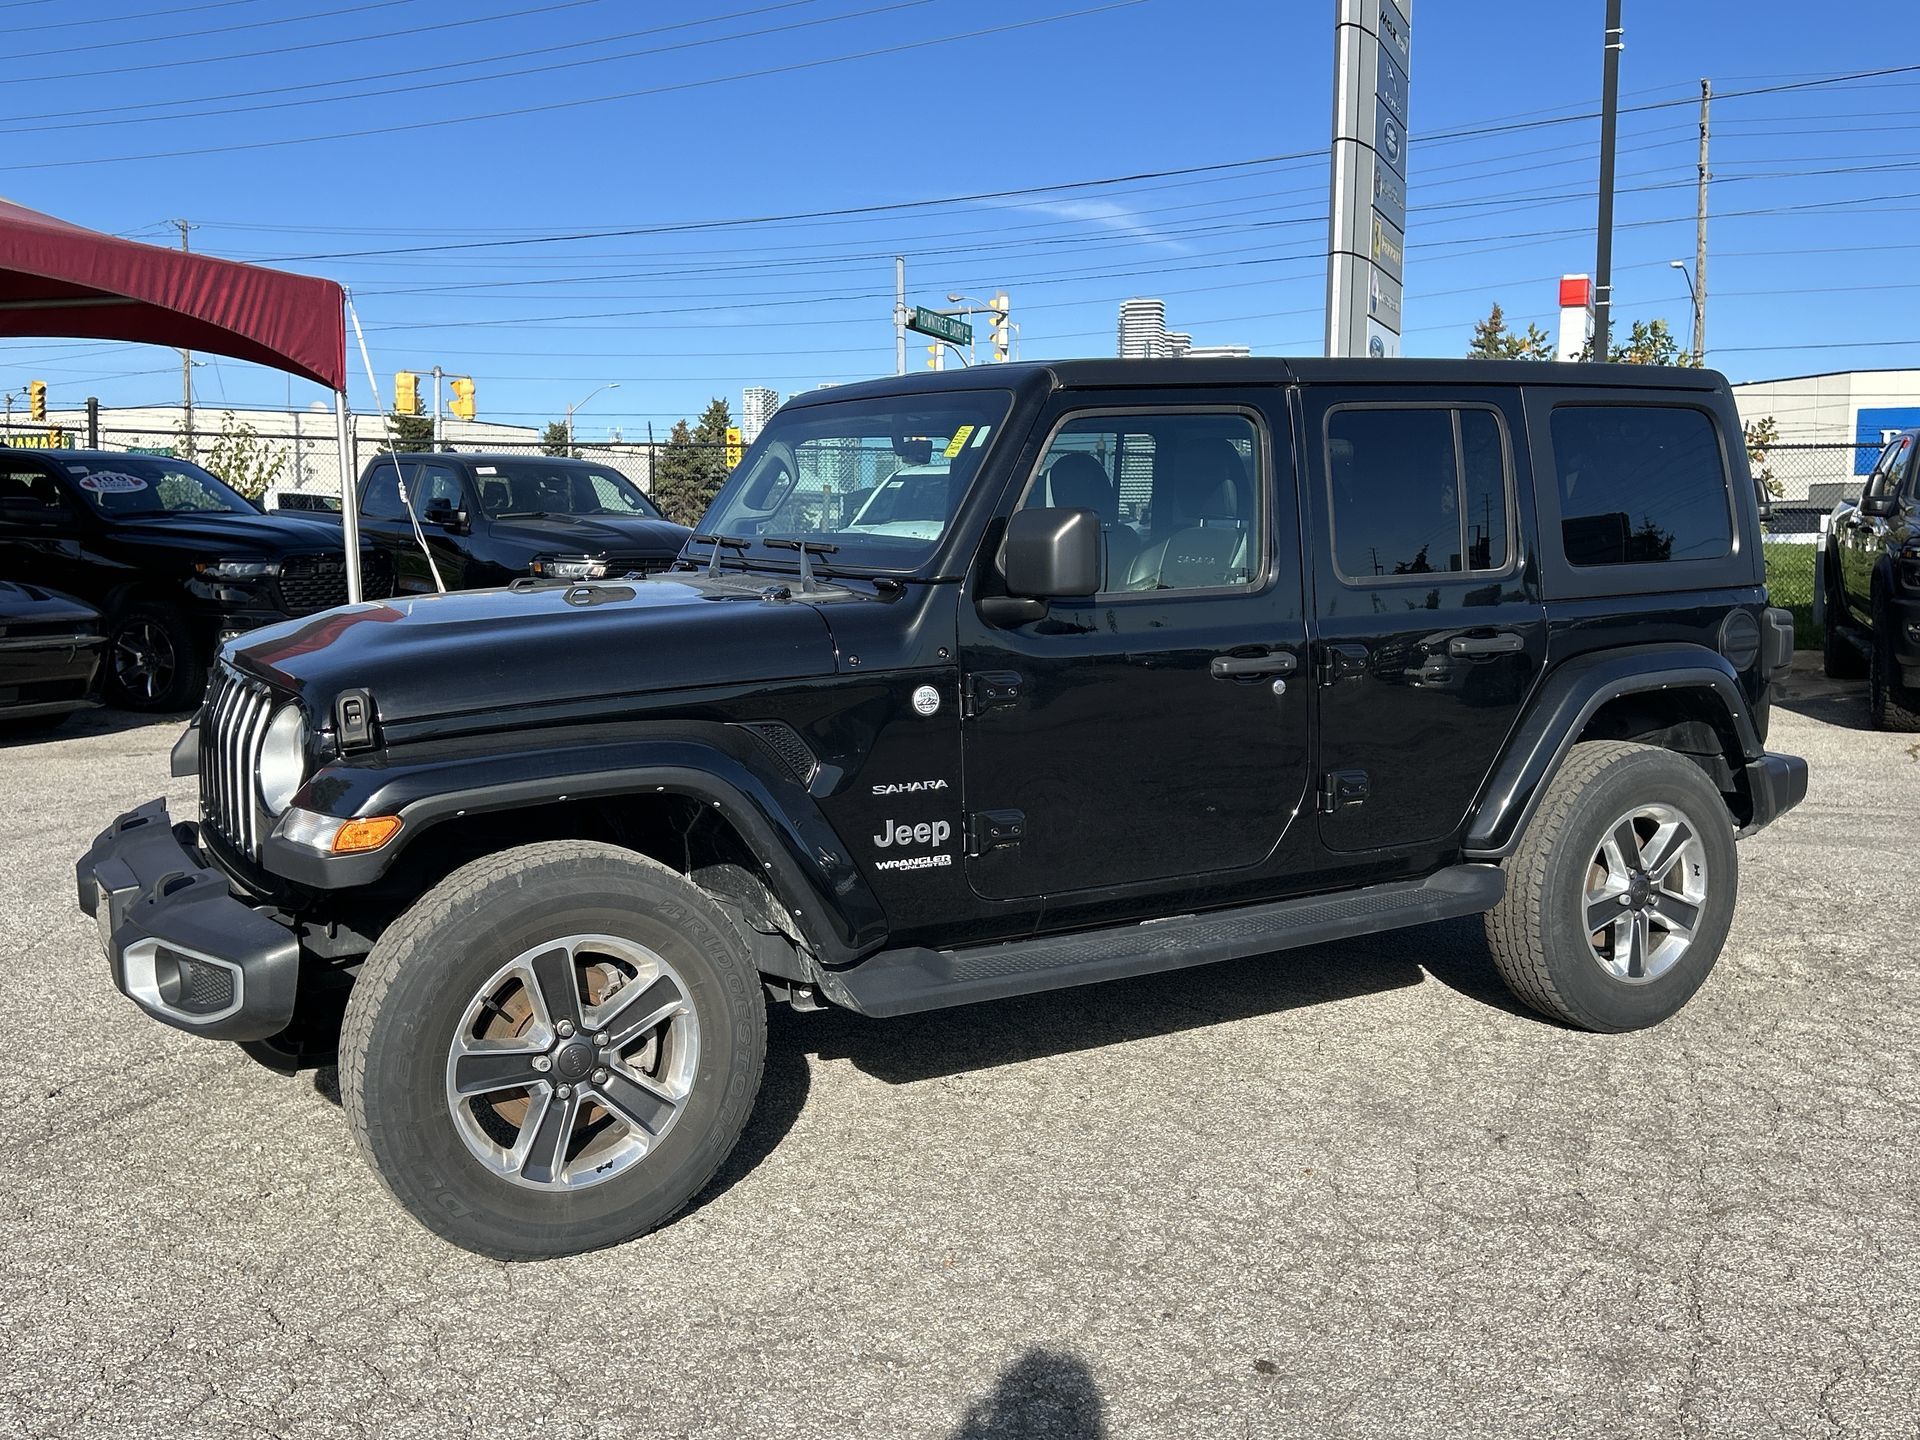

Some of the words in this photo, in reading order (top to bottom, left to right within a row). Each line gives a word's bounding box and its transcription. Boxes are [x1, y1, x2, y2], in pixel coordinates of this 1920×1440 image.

[872, 779, 949, 795] SAHARA
[873, 819, 951, 848] Jeep
[875, 854, 951, 870] WRANGLER
[899, 860, 952, 871] UNLIMITED
[653, 897, 753, 1152] BRIDGESTONE
